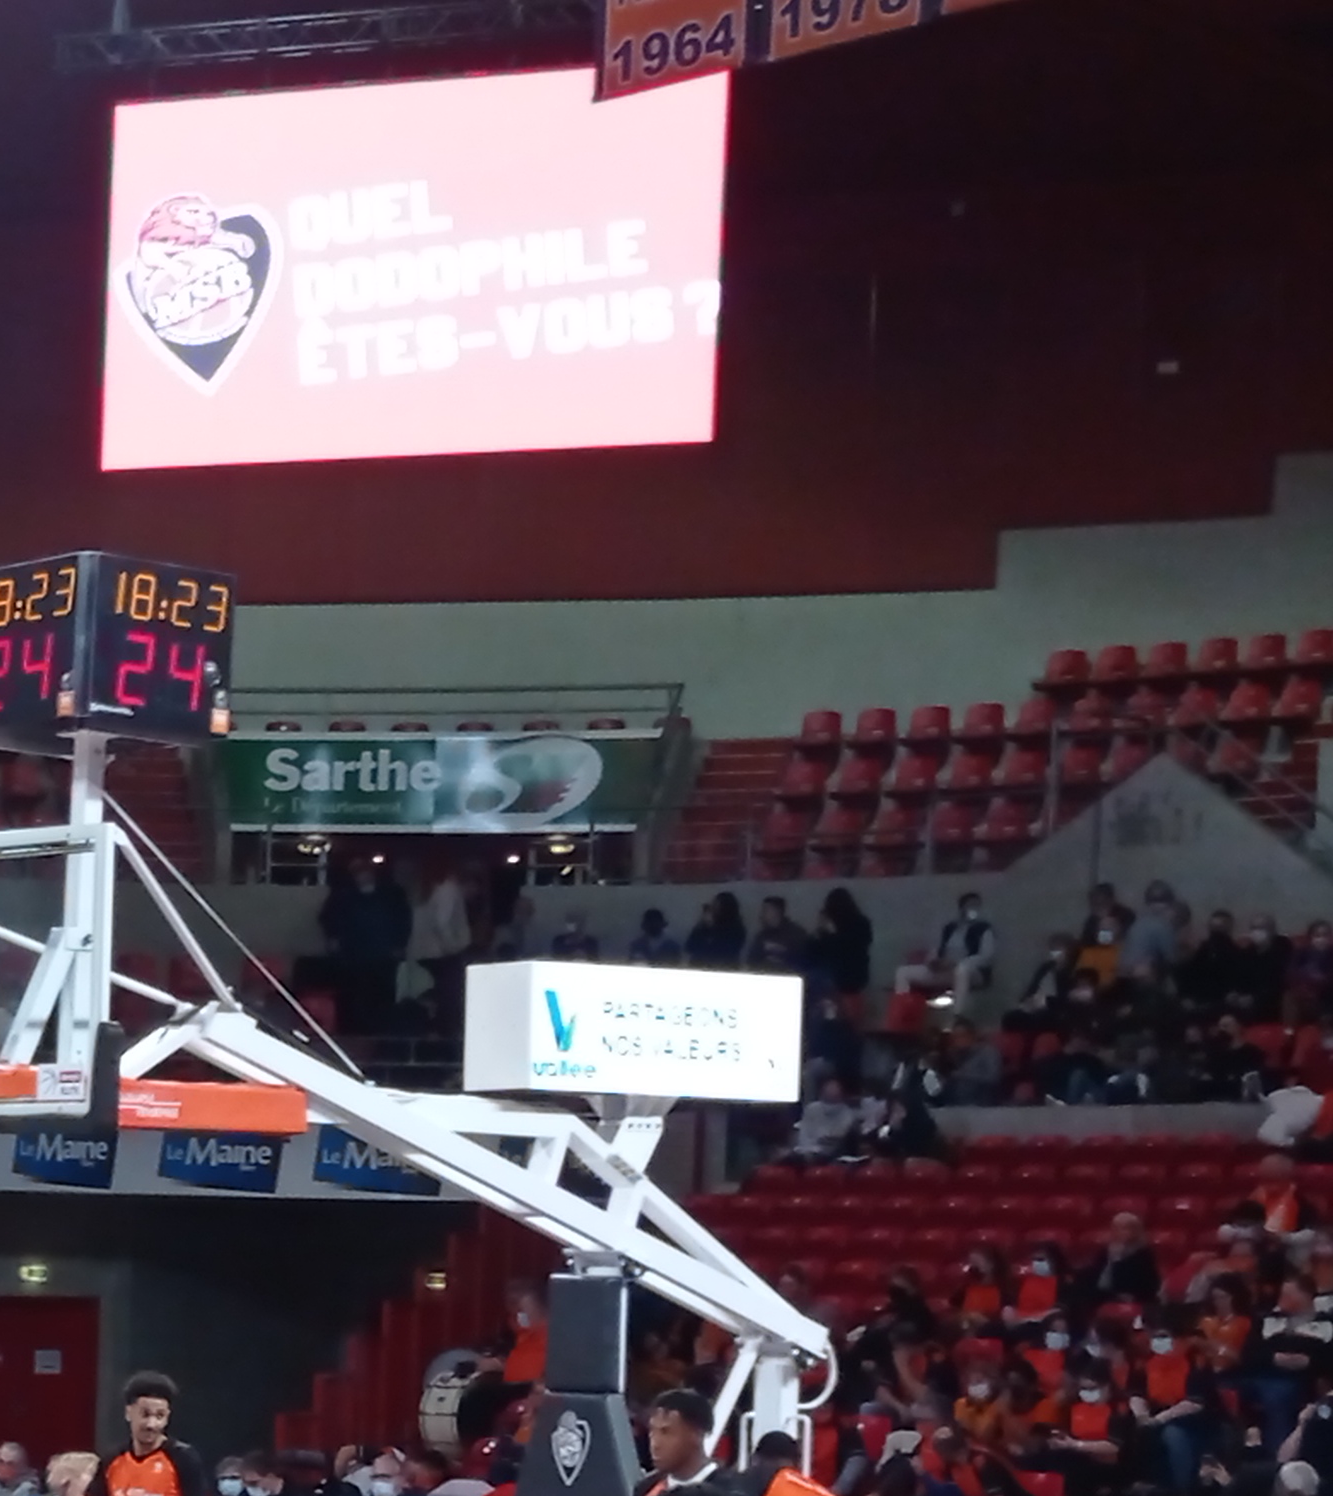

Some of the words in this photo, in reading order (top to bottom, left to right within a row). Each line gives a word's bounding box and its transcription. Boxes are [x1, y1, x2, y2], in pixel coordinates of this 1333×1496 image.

[611, 12, 736, 83] 1964
[288, 180, 453, 250] QUEL
[153, 261, 251, 327] MSB
[114, 570, 230, 634] 18:23
[115, 633, 208, 713] 24
[263, 748, 442, 793] Sarthe
[36, 1133, 108, 1161] Maine
[185, 1137, 272, 1167] Maine
